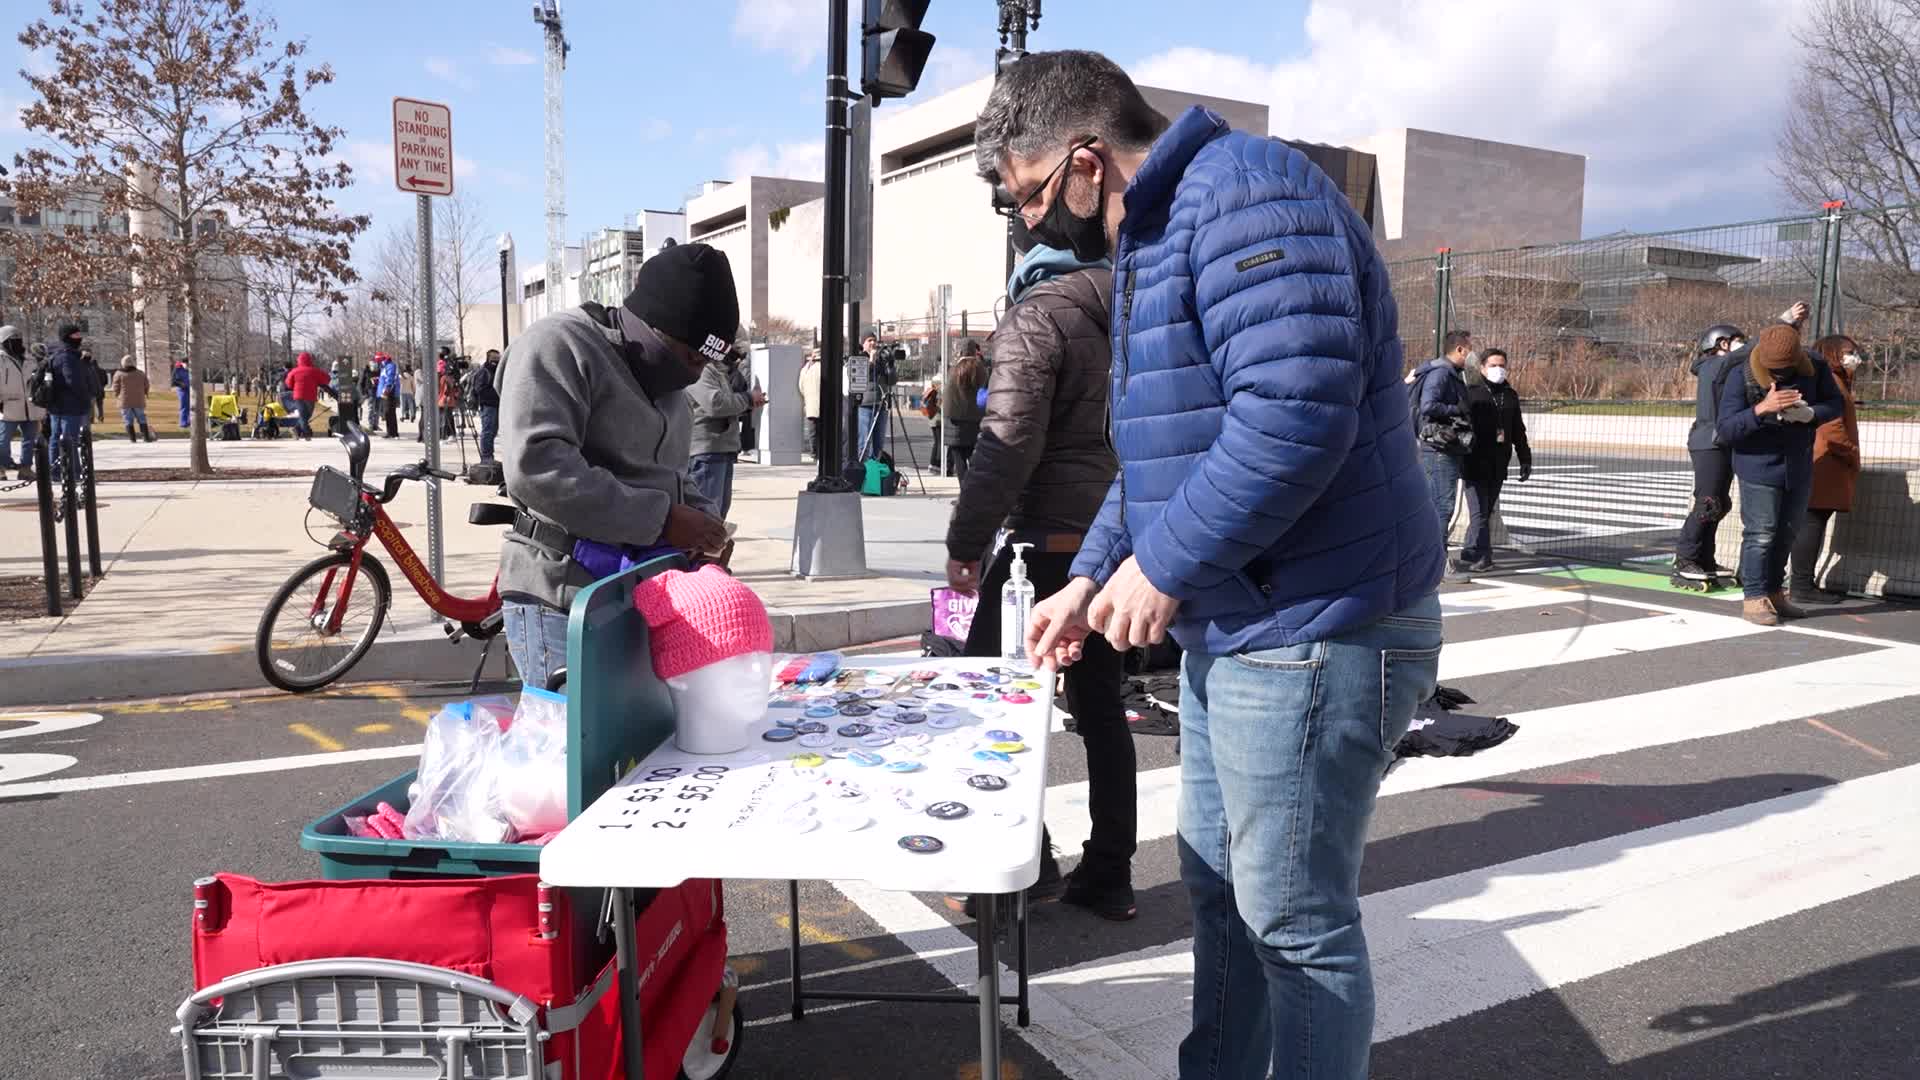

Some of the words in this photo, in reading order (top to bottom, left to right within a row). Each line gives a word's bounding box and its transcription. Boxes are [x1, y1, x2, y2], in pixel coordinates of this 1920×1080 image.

[414, 110, 429, 123] NO
[398, 120, 447, 139] STANDING
[401, 142, 445, 159] PARKING
[399, 157, 420, 170] ANY
[424, 160, 448, 174] TIME
[402, 553, 440, 604] bikeshare
[625, 767, 682, 803] $3.00
[651, 820, 687, 829] 2
[674, 765, 730, 802] $5.00
